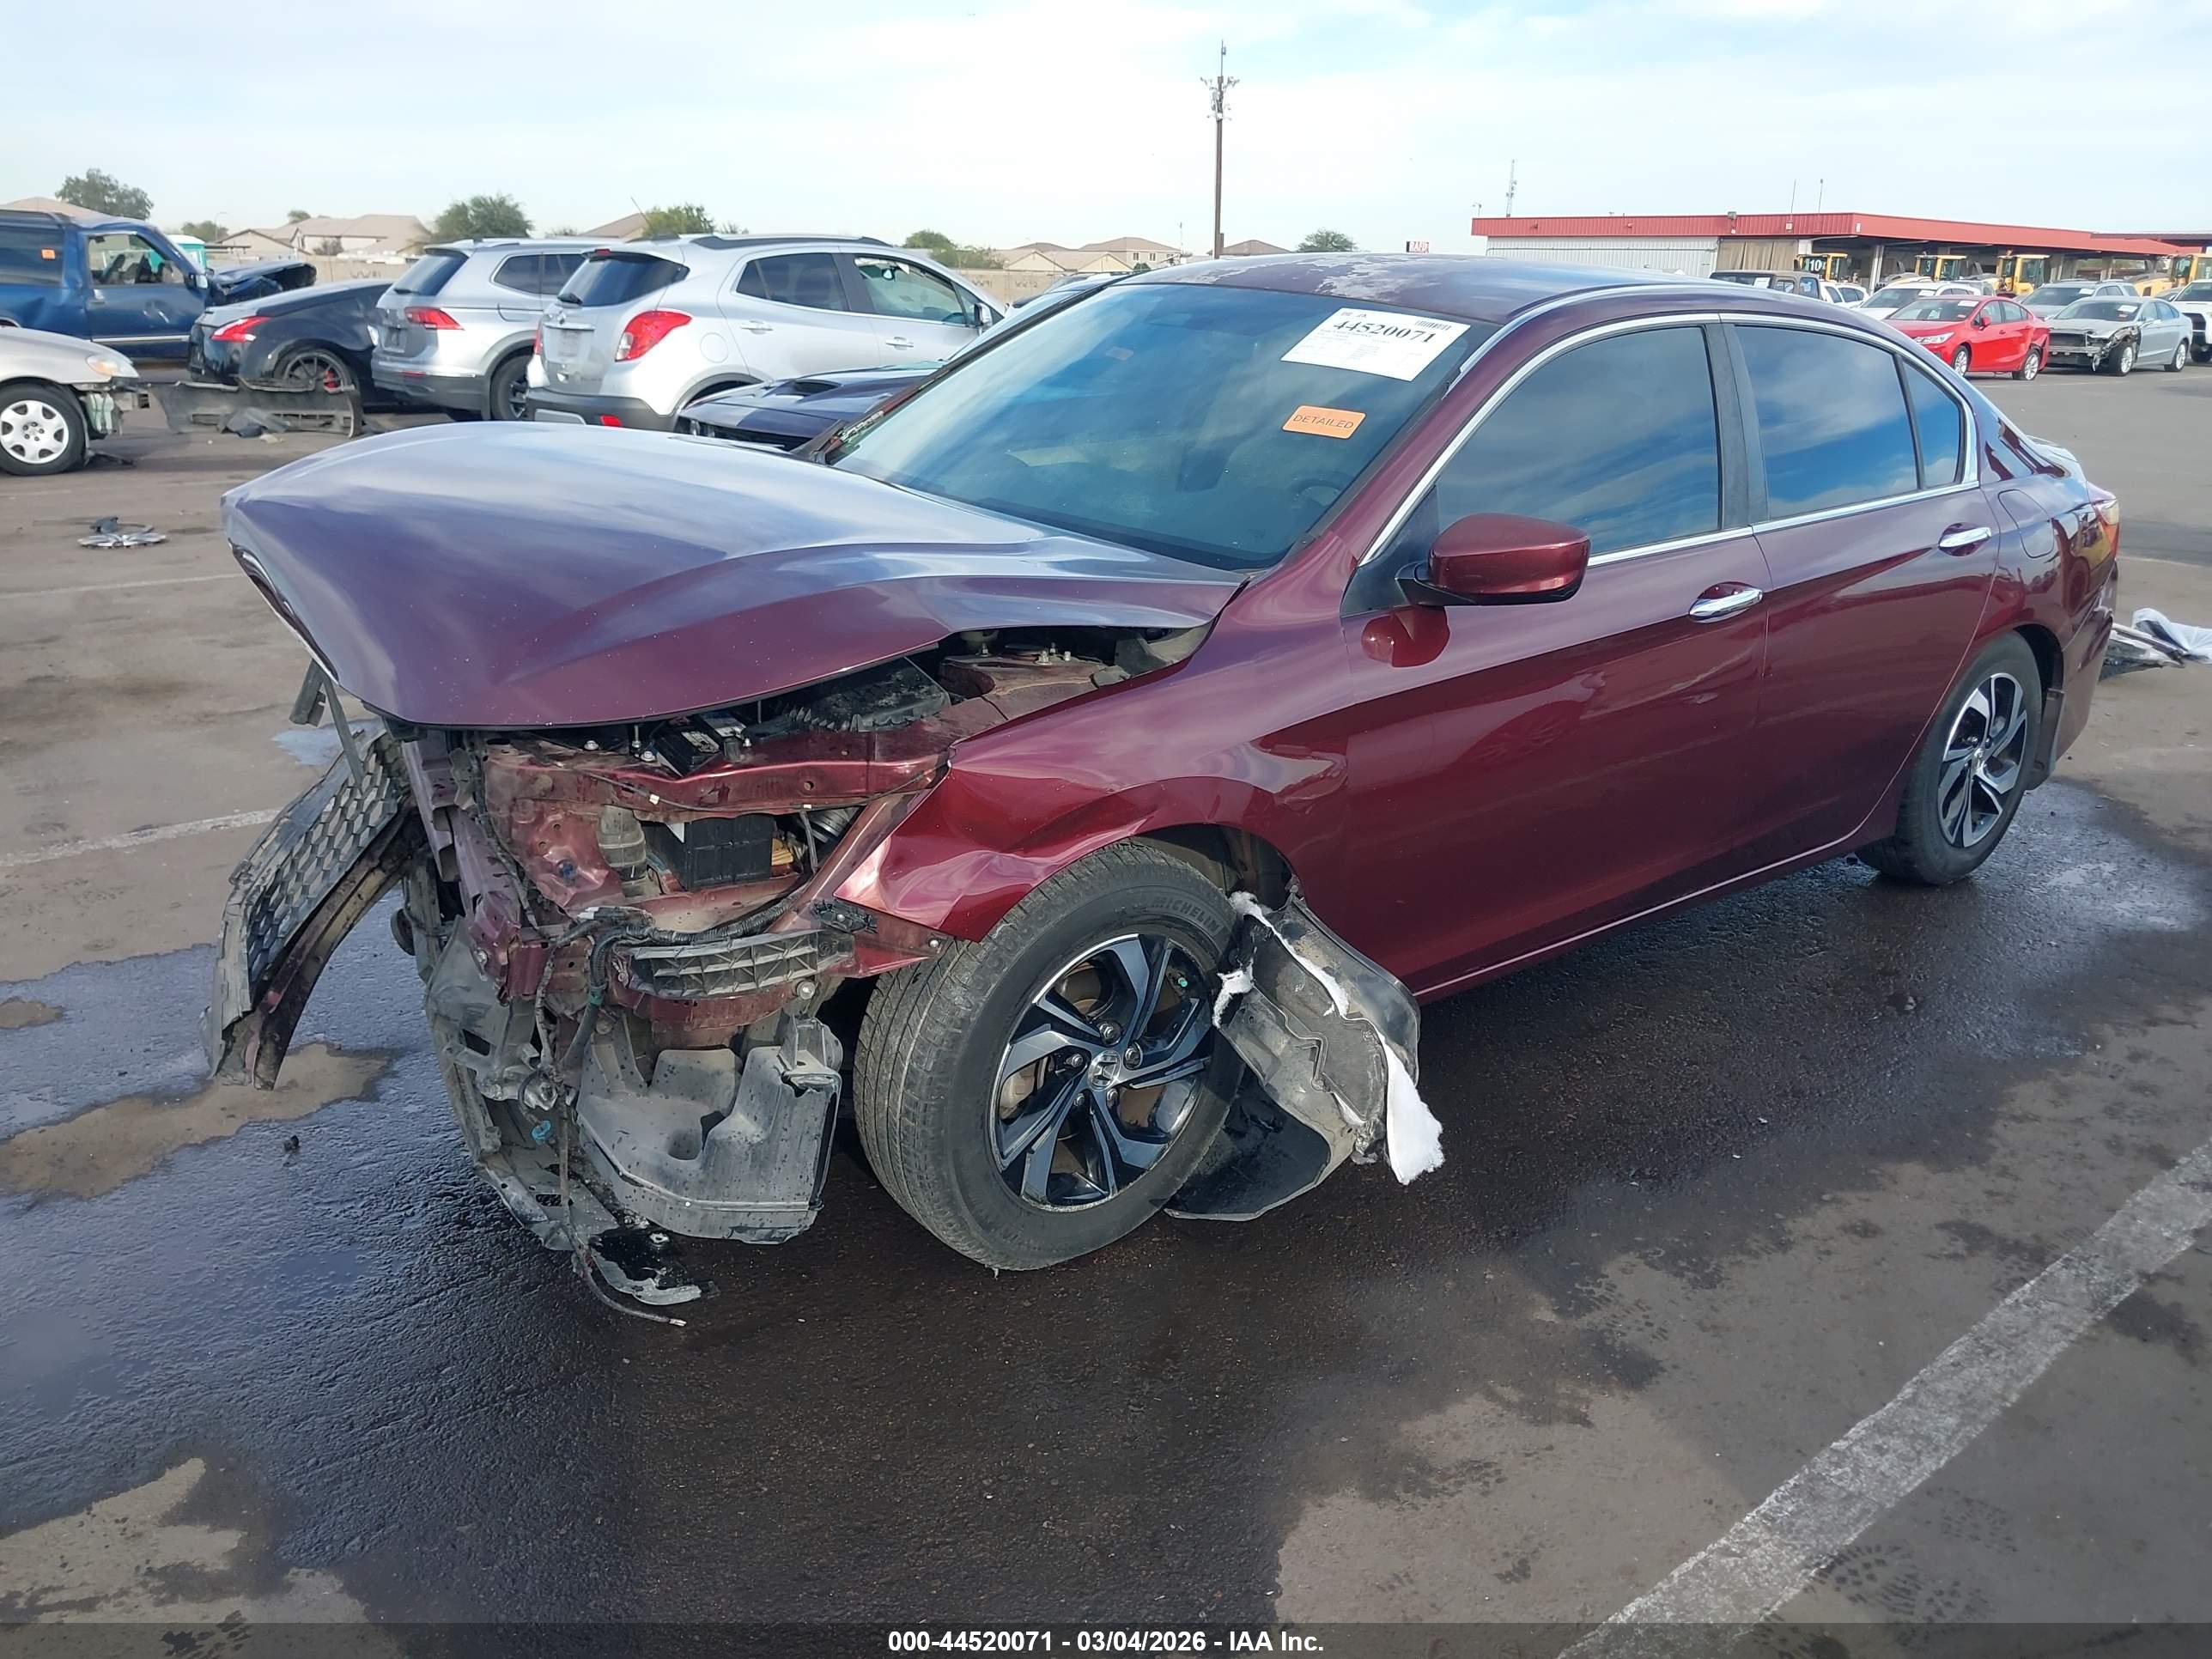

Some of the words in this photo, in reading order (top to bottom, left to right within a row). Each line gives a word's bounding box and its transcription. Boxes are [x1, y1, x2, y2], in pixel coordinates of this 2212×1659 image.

[1334, 320, 1436, 343] 44520071
[1293, 414, 1354, 428] DETAILED
[1152, 896, 1220, 933] MICHELIN
